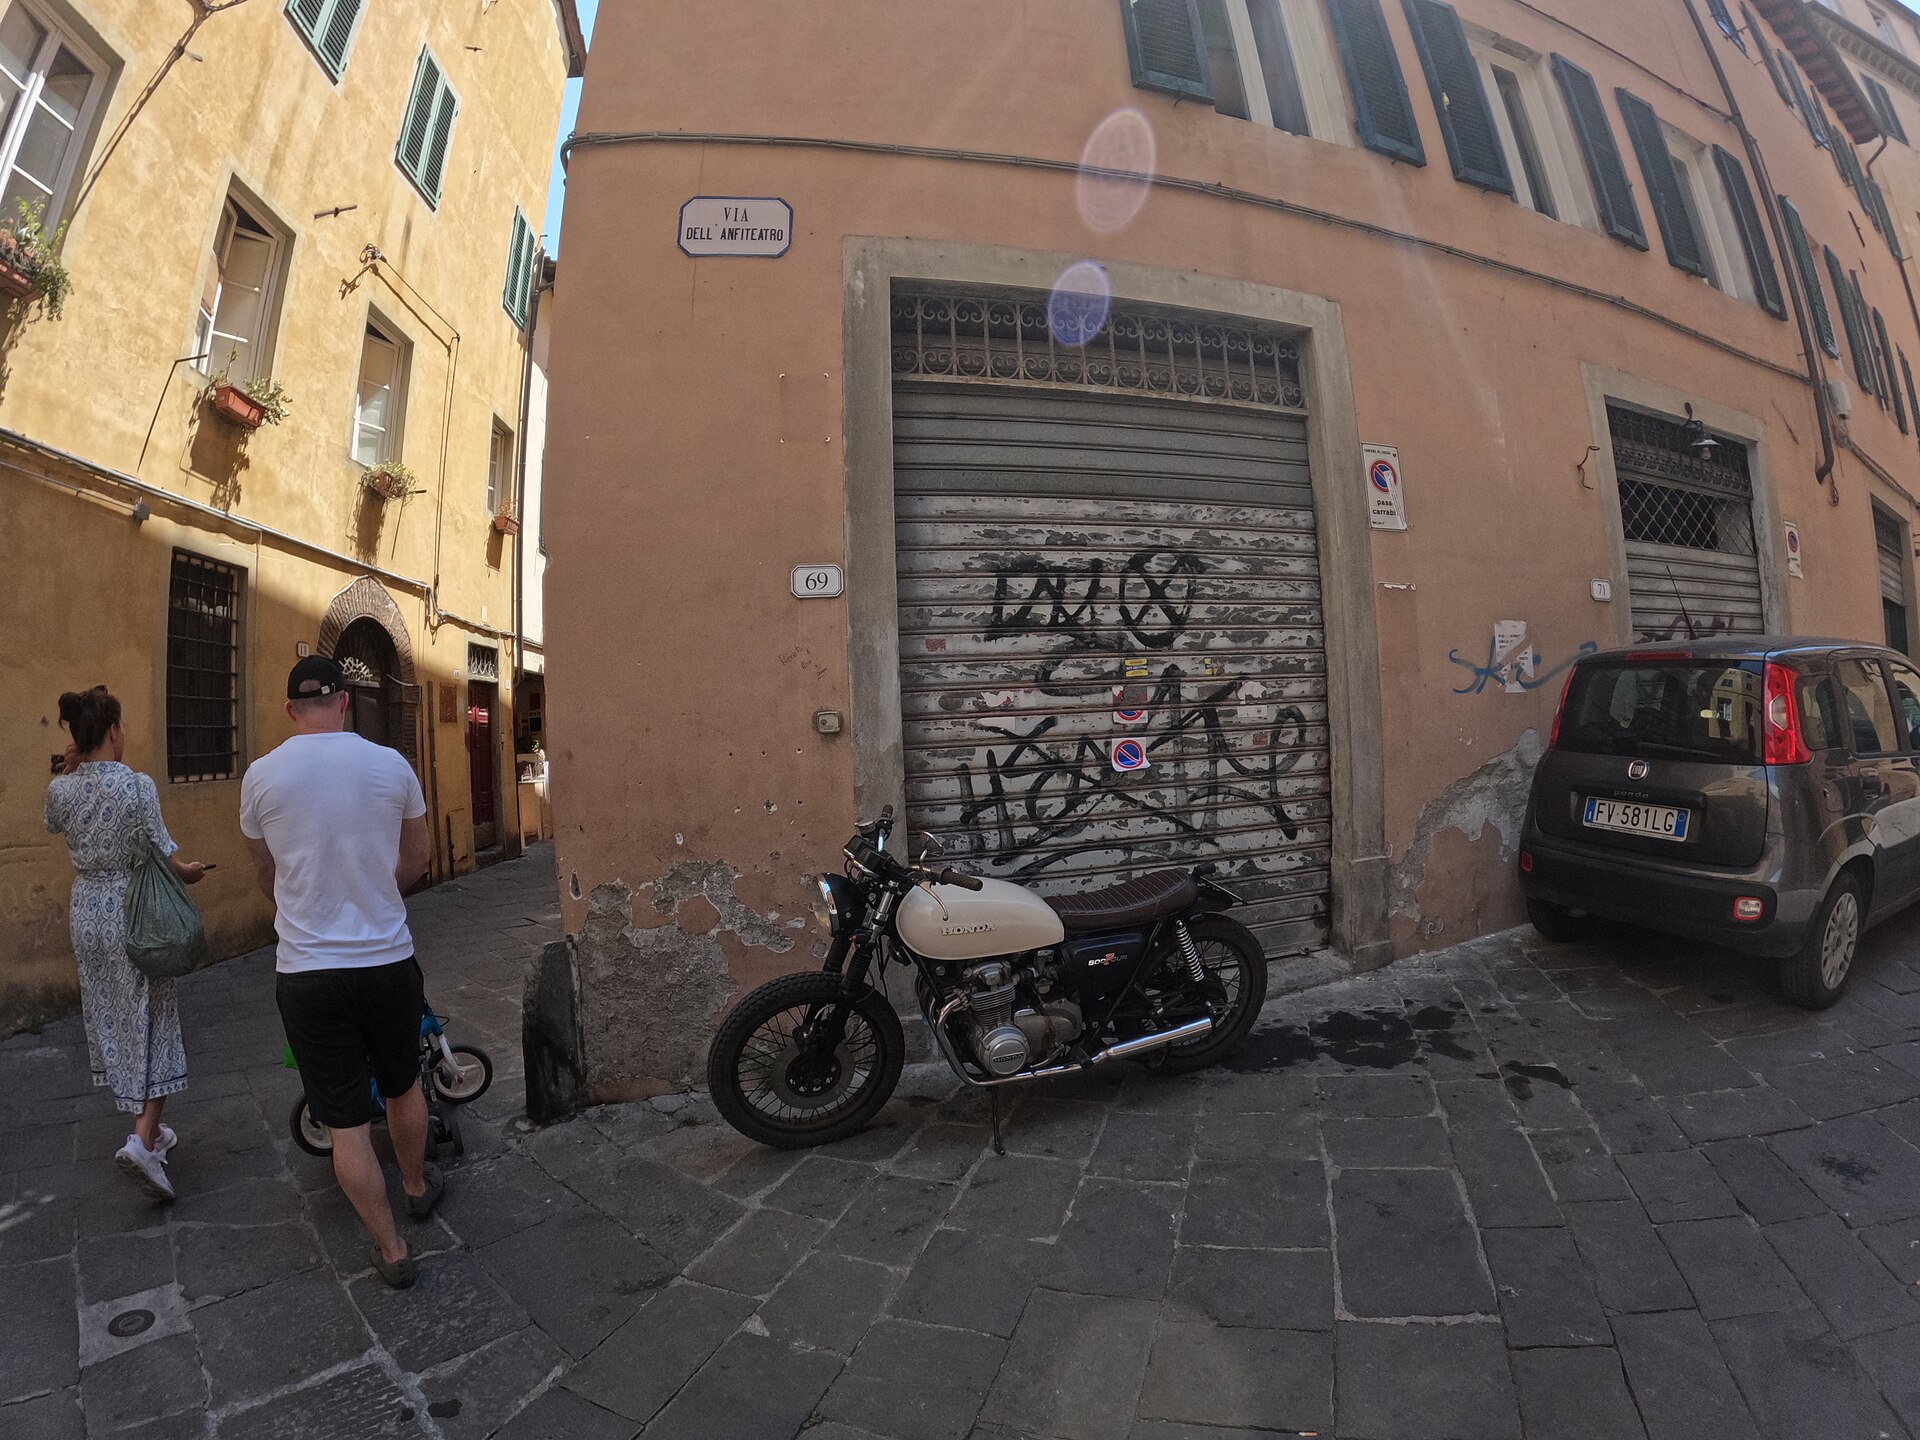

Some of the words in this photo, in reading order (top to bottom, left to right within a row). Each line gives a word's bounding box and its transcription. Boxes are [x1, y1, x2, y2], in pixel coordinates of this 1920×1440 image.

[724, 207, 749, 222] VIA
[720, 227, 784, 242] ANFITEATRO
[1376, 499, 1393, 507] pass
[805, 571, 829, 591] 69
[1597, 583, 1606, 596] 71
[300, 644, 308, 656] 18
[1613, 789, 1649, 799] panda
[941, 923, 997, 936] HONDA
[993, 1052, 1024, 1063] HONDA
